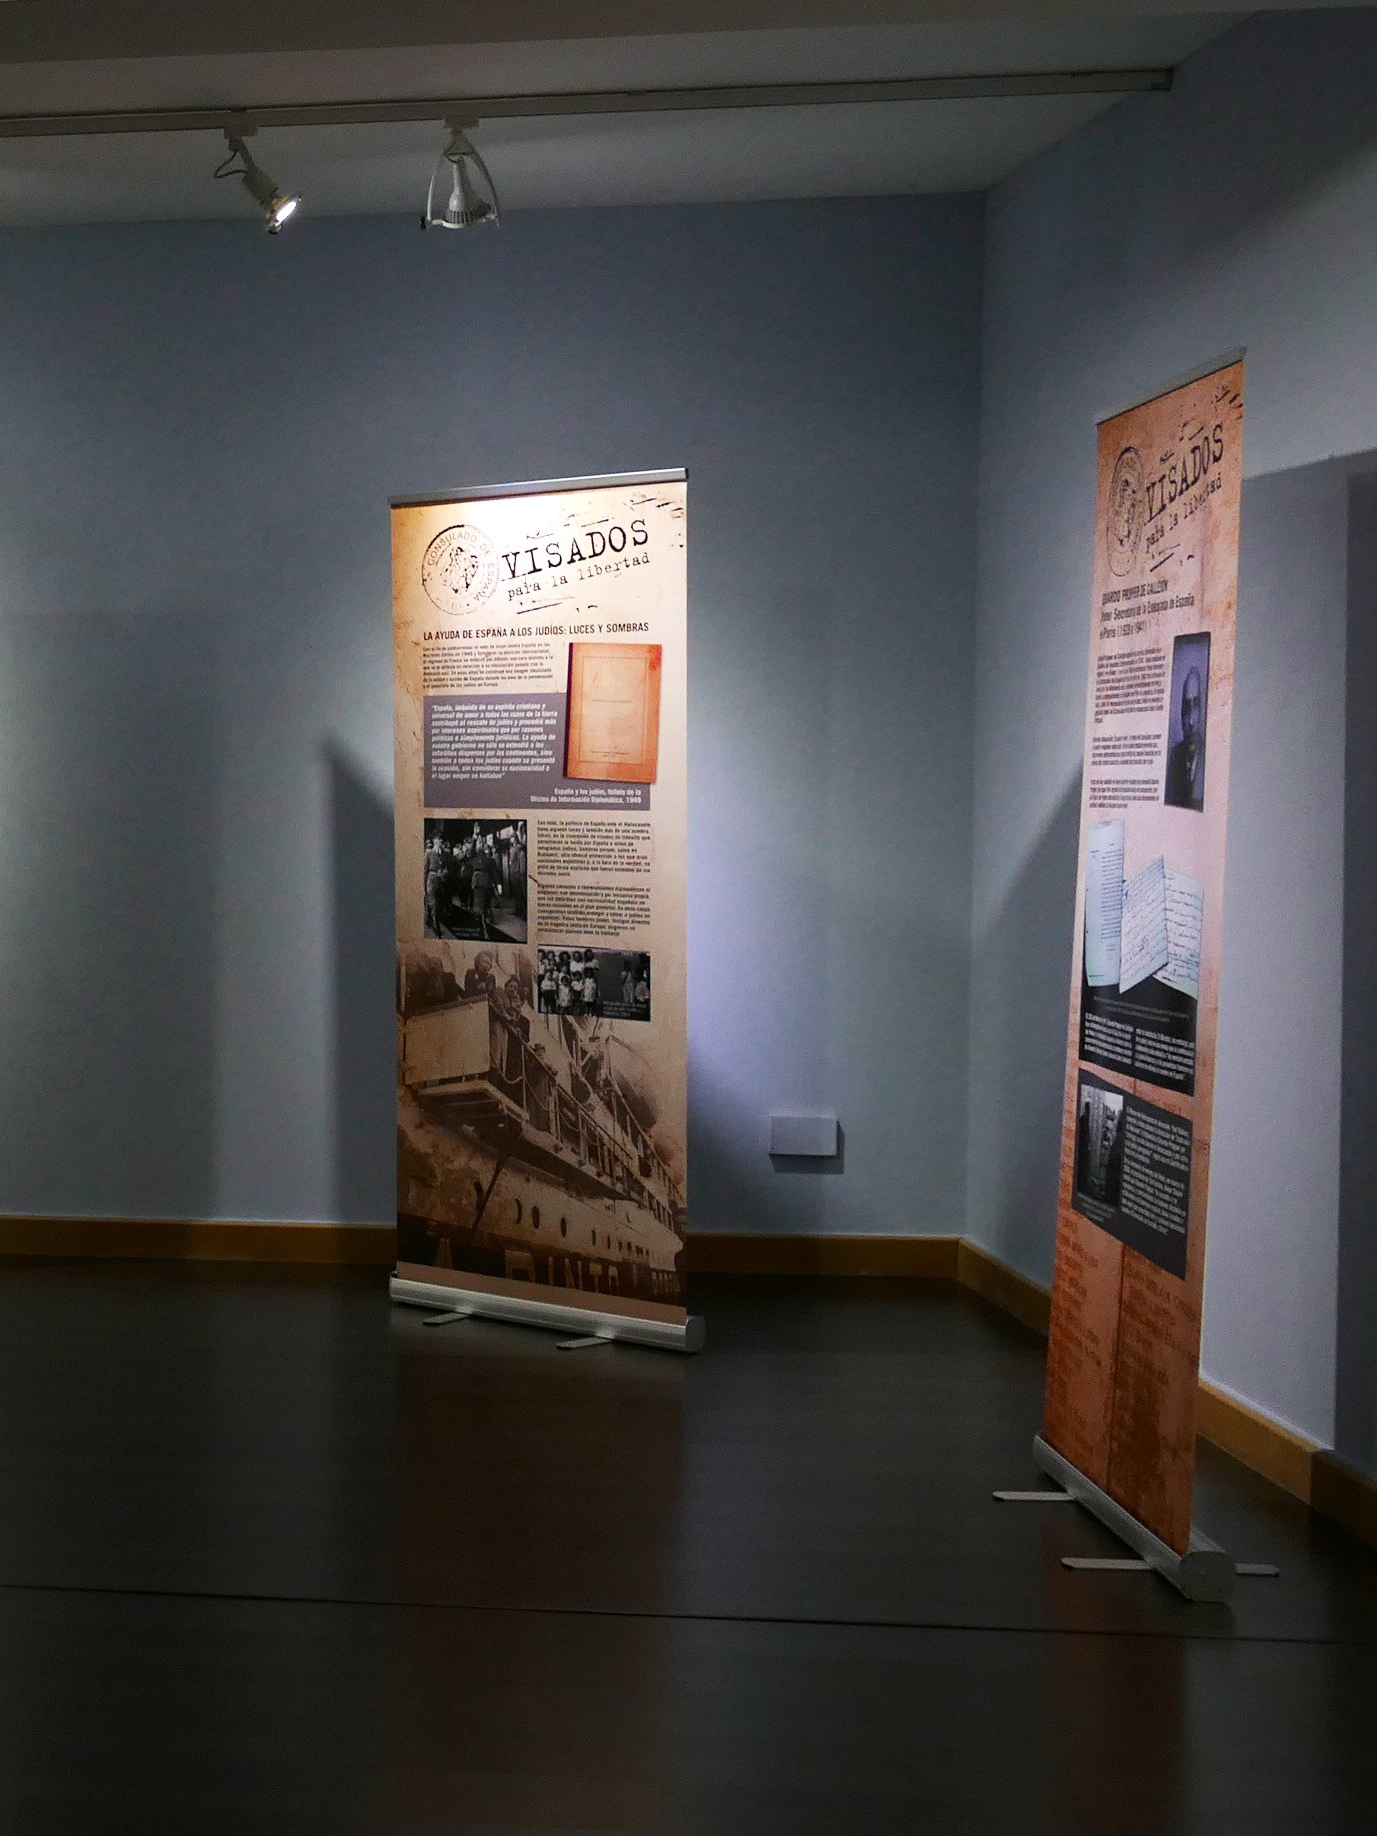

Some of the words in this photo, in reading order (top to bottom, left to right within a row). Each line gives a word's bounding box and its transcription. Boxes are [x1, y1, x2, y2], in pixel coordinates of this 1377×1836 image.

[1146, 422, 1224, 522] VISADOS
[1170, 513, 1178, 531] la
[1184, 472, 1222, 519] libertad
[428, 532, 477, 566] CONSULADO
[480, 543, 491, 556] DE
[502, 519, 648, 578] VISADOS
[473, 563, 494, 601] ESPAÑA
[508, 582, 541, 601] para
[552, 575, 568, 587] la
[578, 552, 650, 581] libertad
[424, 630, 433, 641] LA
[435, 630, 460, 640] AYUDA
[463, 630, 473, 639] DE
[476, 627, 507, 639] ESPAÑA
[510, 628, 516, 637] A
[518, 628, 532, 637] LOS
[535, 624, 567, 636] JUDÍOS:
[569, 624, 595, 634] LUCES
[598, 624, 603, 633] Y
[606, 622, 649, 632] SOMBRAS
